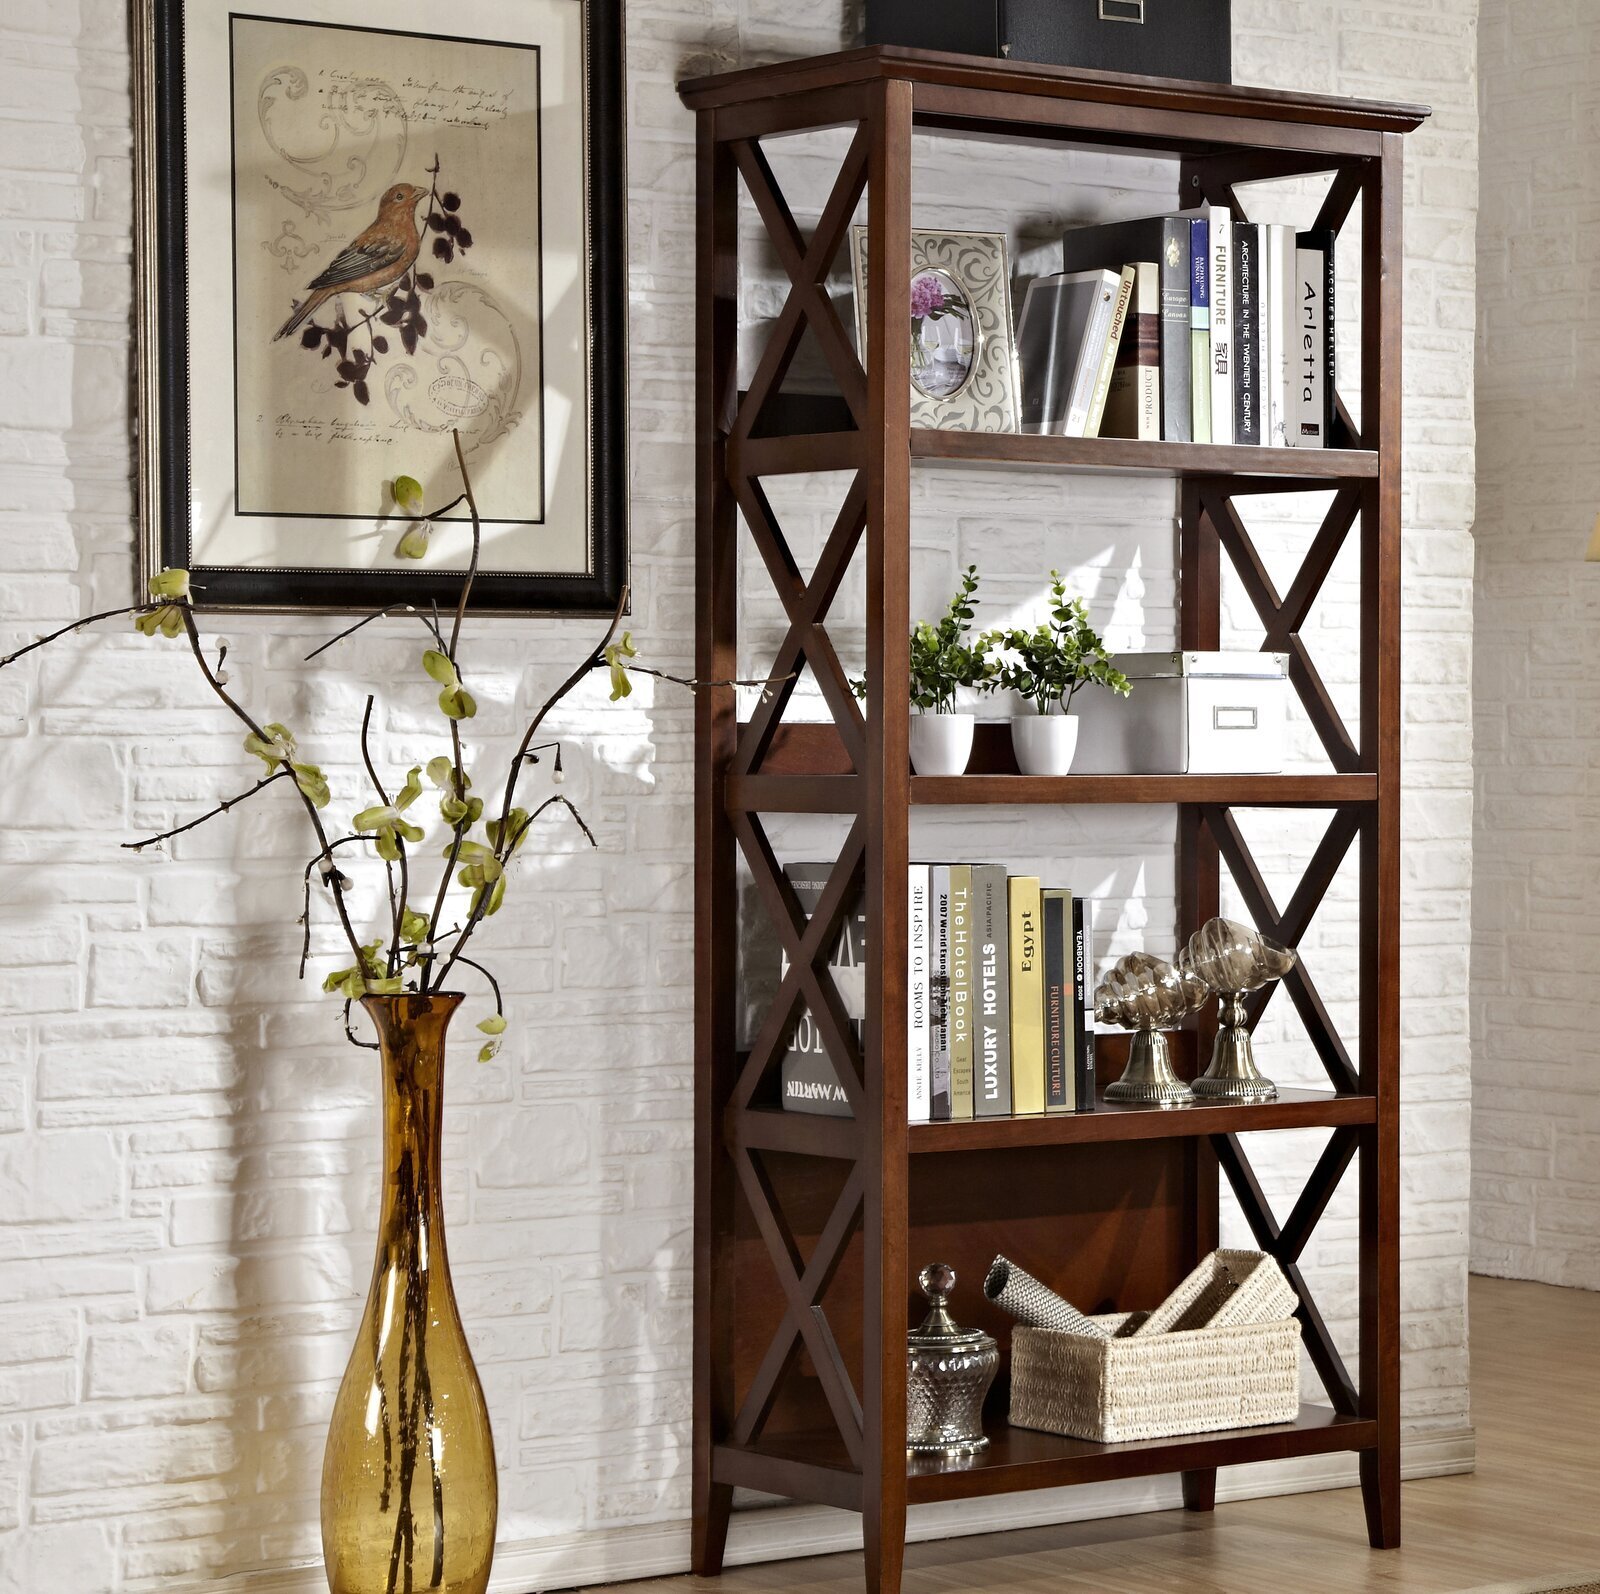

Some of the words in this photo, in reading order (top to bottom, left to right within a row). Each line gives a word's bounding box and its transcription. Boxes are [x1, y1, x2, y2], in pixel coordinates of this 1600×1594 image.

[1215, 245, 1226, 325] FURNITURE
[1241, 240, 1249, 305] ARCHITECTURE
[1110, 280, 1132, 341] Untouched
[1242, 309, 1250, 319] IN
[1242, 323, 1250, 339] THE
[1215, 342, 1228, 375] 家具
[1243, 343, 1251, 387] TWENTIETH
[1303, 281, 1317, 402] Arletta
[1144, 368, 1153, 415] PRODUCT
[1243, 392, 1251, 433] CENTURY
[913, 885, 924, 949] INSPIRE
[955, 887, 967, 926] The
[940, 919, 948, 948] World
[955, 930, 967, 986] Hotel
[1021, 910, 1035, 972] Egypt
[913, 956, 924, 974] TO
[982, 943, 997, 1015] HOTELS
[913, 982, 924, 1029] ROOMS
[955, 991, 967, 1043] Book
[1050, 985, 1060, 1047] FURNITURE
[983, 1025, 998, 1100] LUXURY
[1051, 1047, 1061, 1096] CULTURE
[786, 1080, 832, 1101] MARTIN
